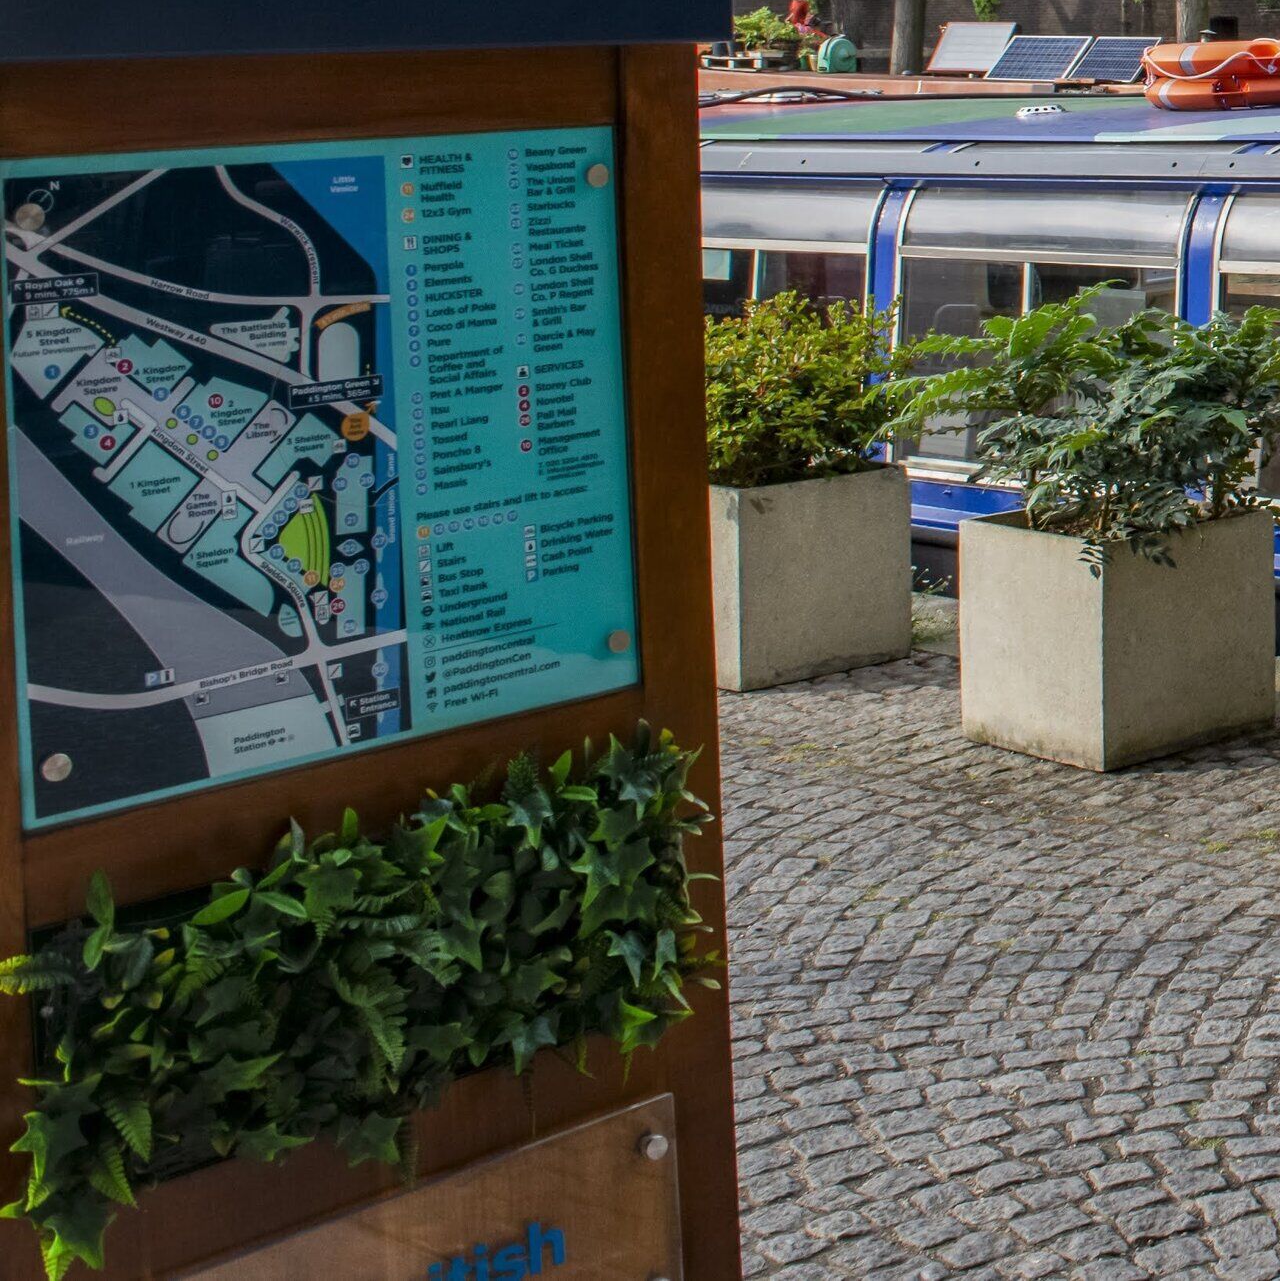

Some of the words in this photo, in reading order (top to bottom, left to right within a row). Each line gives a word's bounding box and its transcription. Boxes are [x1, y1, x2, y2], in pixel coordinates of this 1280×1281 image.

[525, 147, 556, 159] Beany
[557, 145, 588, 156] Green
[419, 153, 461, 165] HEALTH
[420, 164, 465, 175] FITNESS
[420, 181, 463, 192] Nuffield
[421, 192, 455, 203] Health
[448, 206, 472, 218] Gym
[527, 199, 576, 212] Starbucks
[423, 233, 462, 245] DINING
[423, 244, 460, 256] SHOPS
[424, 261, 464, 272] Pergola
[529, 254, 568, 266] London
[24, 280, 52, 291] Royal
[54, 278, 74, 287] Oak
[424, 275, 473, 288] Elements
[150, 279, 184, 294] Harrow
[186, 288, 210, 300] Road
[425, 288, 483, 302] HUCKSTER
[426, 306, 456, 318] Lords
[471, 301, 497, 313] Poke
[146, 317, 186, 339] Westway
[187, 334, 207, 346] A40
[220, 326, 238, 334] The
[240, 321, 286, 334] Battleship
[427, 322, 453, 333] Coco
[467, 317, 498, 328] Mama
[36, 326, 82, 338] Kingdom
[249, 330, 287, 340] Building
[533, 331, 565, 342] Darcie
[39, 336, 70, 346] Street
[427, 337, 452, 348] Pure
[533, 342, 563, 353] Green
[428, 347, 491, 364] Department
[493, 345, 504, 355] of
[143, 363, 187, 376] Kingdom
[429, 363, 464, 374] Coffee
[465, 359, 486, 370] and
[534, 359, 585, 375] SERVICES
[76, 375, 121, 388] Kingdom
[146, 374, 175, 384] Street
[429, 373, 460, 385] Social
[463, 369, 497, 381] Affairs
[83, 385, 118, 396] Square
[292, 381, 343, 396] Paddington
[345, 378, 370, 389] Green
[535, 380, 567, 392] Storey
[569, 377, 592, 388] Club
[430, 389, 452, 400] Pret
[465, 383, 504, 396] Manger
[536, 393, 575, 407] Novotel
[210, 407, 253, 419] Kingdom
[218, 418, 246, 427] Street
[253, 422, 270, 430] The
[431, 419, 458, 431] Pearl
[460, 414, 490, 427] Liang
[537, 419, 576, 431] Barbers
[245, 429, 278, 440] Library
[295, 432, 331, 444] Sheldon
[432, 431, 469, 445] Tossed
[538, 428, 601, 446] Management
[152, 427, 185, 457] Kingdom
[185, 452, 209, 474] Street
[294, 443, 325, 453] Square
[432, 447, 473, 461] Poncho
[433, 459, 492, 476] Sainsbury's
[137, 476, 181, 489] Kingdom
[142, 486, 171, 497] Street
[186, 500, 218, 509] Games
[416, 509, 450, 521] Please
[453, 505, 471, 515] use
[473, 500, 501, 512] stairs
[503, 495, 522, 506] and
[525, 493, 538, 503] lift
[540, 490, 551, 500] to
[188, 508, 216, 518] Room
[540, 520, 575, 534] Bicycle
[577, 513, 614, 527] Parking
[65, 533, 105, 546] Railway
[540, 533, 582, 548] Drinking
[584, 527, 614, 539] Water
[196, 547, 234, 559] Sheldon
[436, 542, 454, 553] Lift
[541, 550, 566, 562] Cash
[568, 545, 593, 557] Point
[196, 557, 230, 568] Square
[437, 555, 467, 567] Stairs
[438, 571, 457, 583] Bus
[460, 567, 484, 580] Stop
[542, 563, 580, 578] Parking
[260, 561, 287, 585] Sheldon
[286, 582, 306, 607] Square
[438, 586, 460, 598] Taxi
[462, 581, 488, 593] Rank
[439, 591, 508, 614] Underground
[440, 610, 484, 627] National
[486, 607, 506, 618] Rail
[441, 625, 491, 643] Heathrow
[493, 617, 534, 634] Express
[441, 636, 536, 665] paddingtoncentral
[442, 652, 532, 679] @PaddingtonCen
[199, 674, 237, 689] Bishop's
[239, 666, 269, 680] Bridge
[270, 659, 294, 671] Road
[443, 660, 561, 695] paddingtoncentral.com
[359, 694, 391, 706] Station
[444, 696, 468, 708] Free
[471, 689, 499, 702] Wi-Fi
[359, 700, 398, 714] Entrance
[233, 726, 286, 745] Paddington
[234, 741, 267, 754] Station
